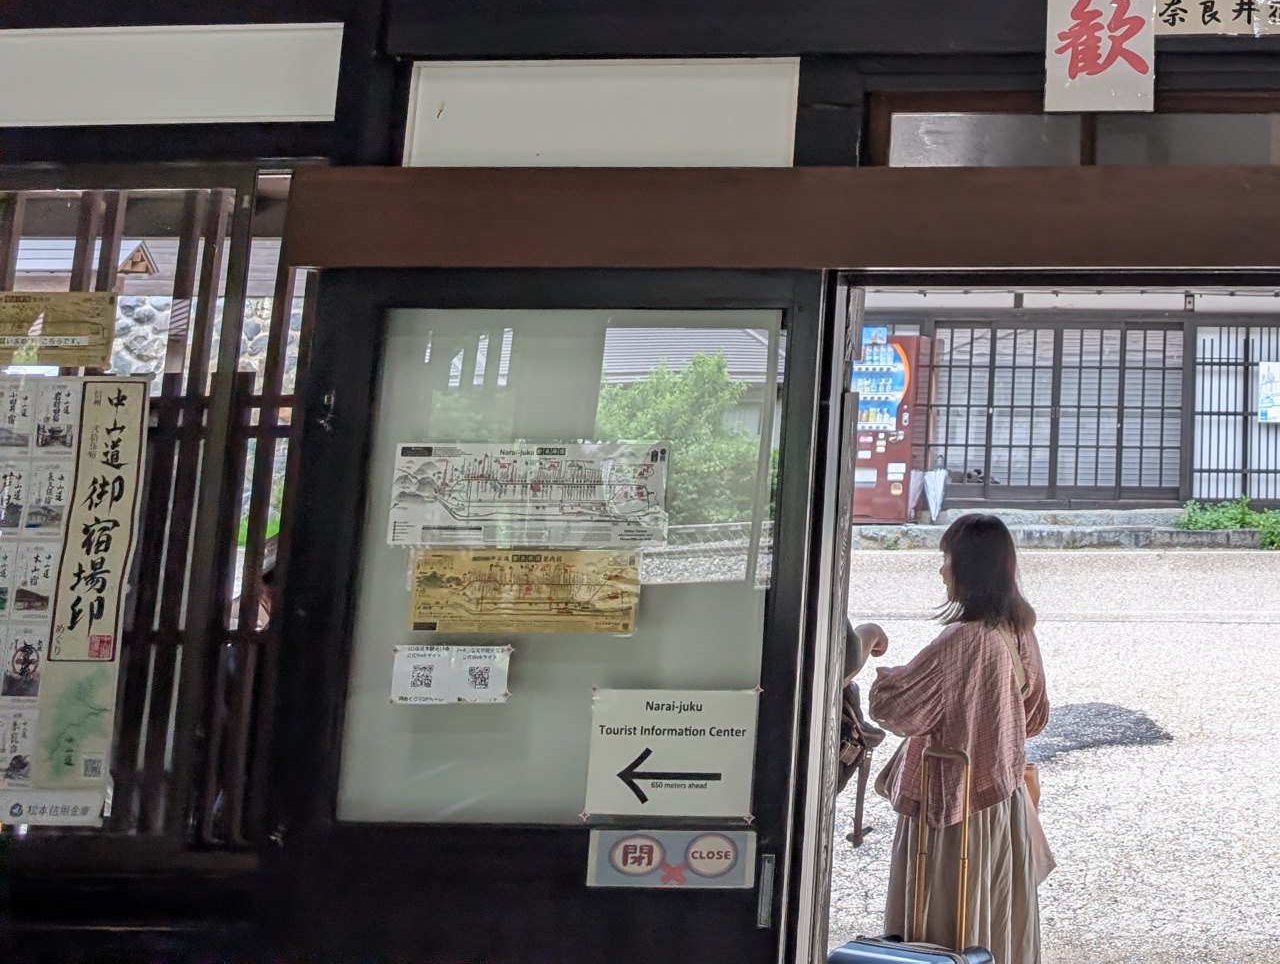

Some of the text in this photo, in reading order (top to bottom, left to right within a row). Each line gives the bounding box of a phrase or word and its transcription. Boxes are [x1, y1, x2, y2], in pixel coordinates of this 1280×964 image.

[645, 700, 703, 713] Narai-juku
[599, 724, 747, 737] Tourist Information Center
[687, 781, 708, 789] ahead
[27, 804, 91, 817] 松本信用金庫
[622, 844, 654, 867] 閉
[691, 850, 731, 860] CLOSE
